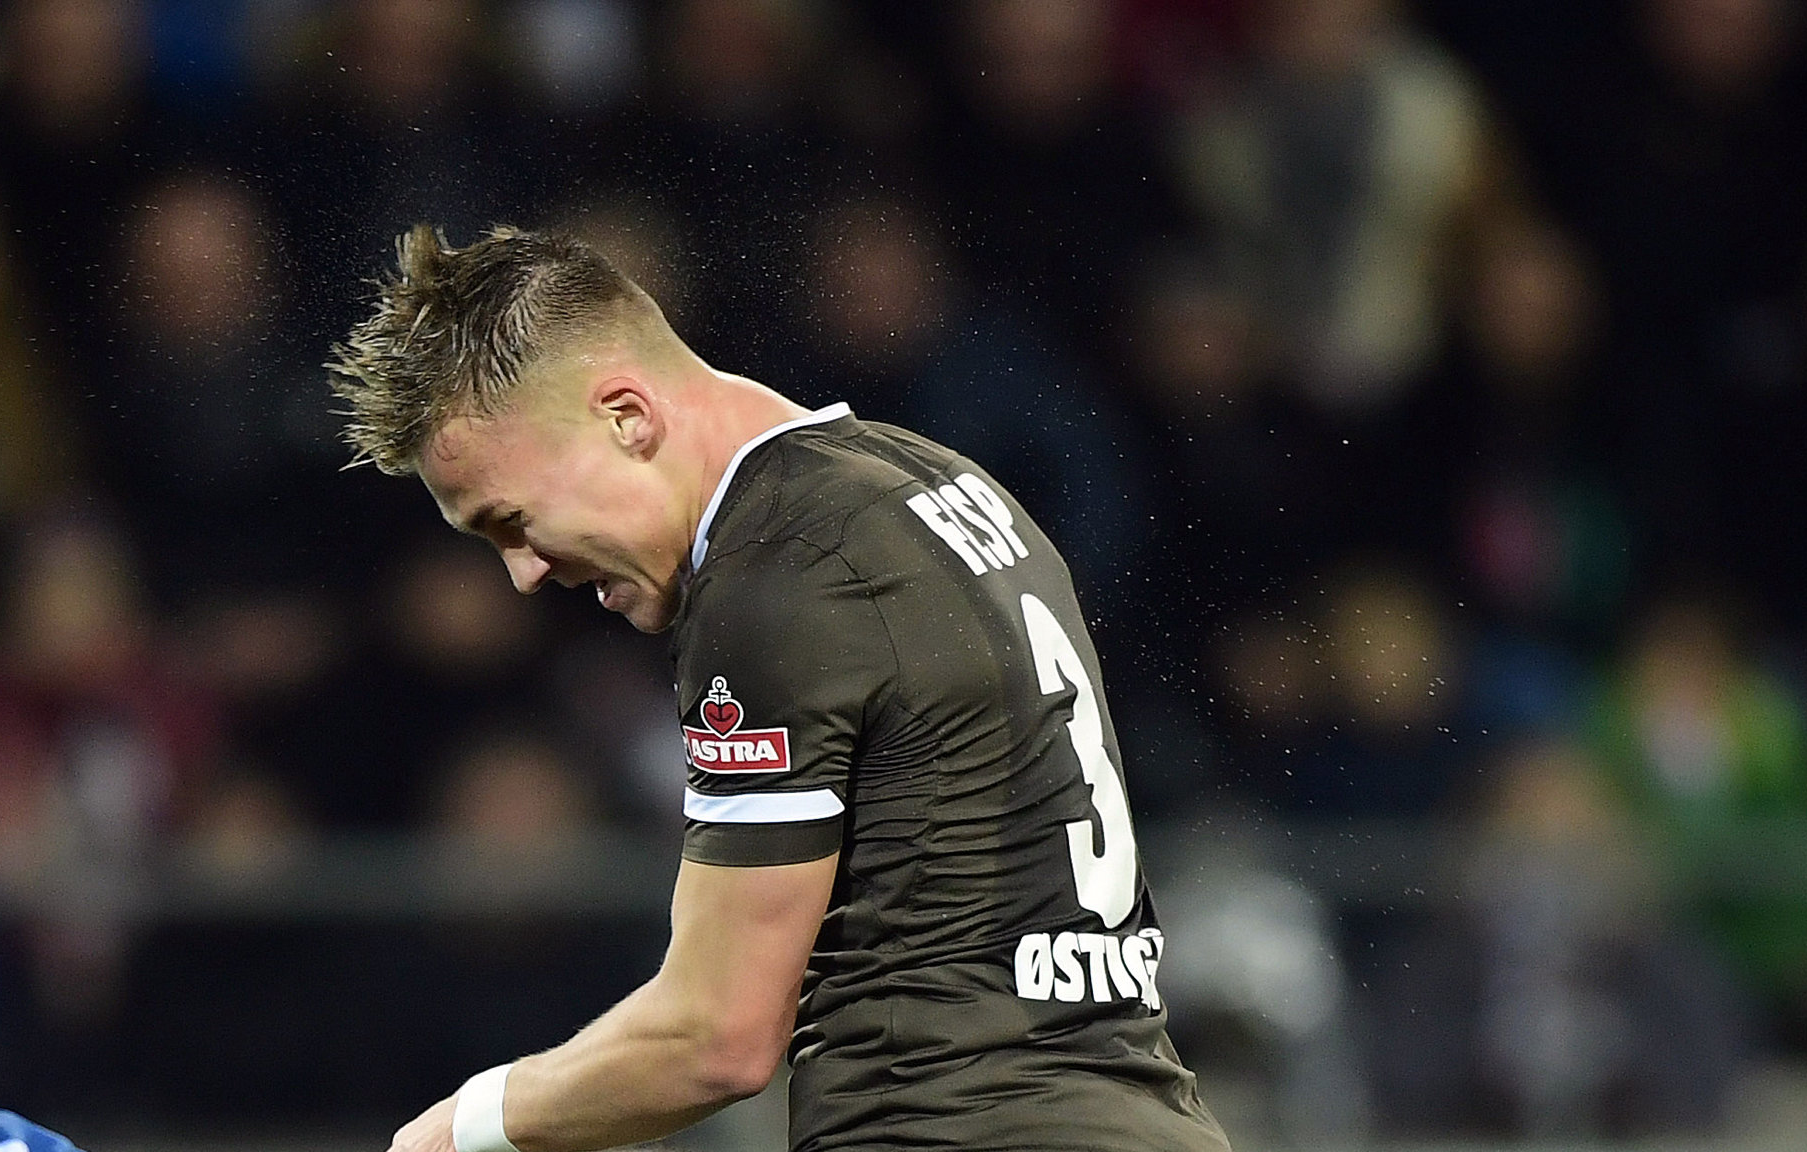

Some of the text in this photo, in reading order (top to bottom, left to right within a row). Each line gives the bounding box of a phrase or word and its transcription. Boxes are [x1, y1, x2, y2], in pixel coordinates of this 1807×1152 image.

[905, 472, 1030, 577] FCSP
[690, 738, 780, 763] ASTRA
[1018, 591, 1137, 930] 3
